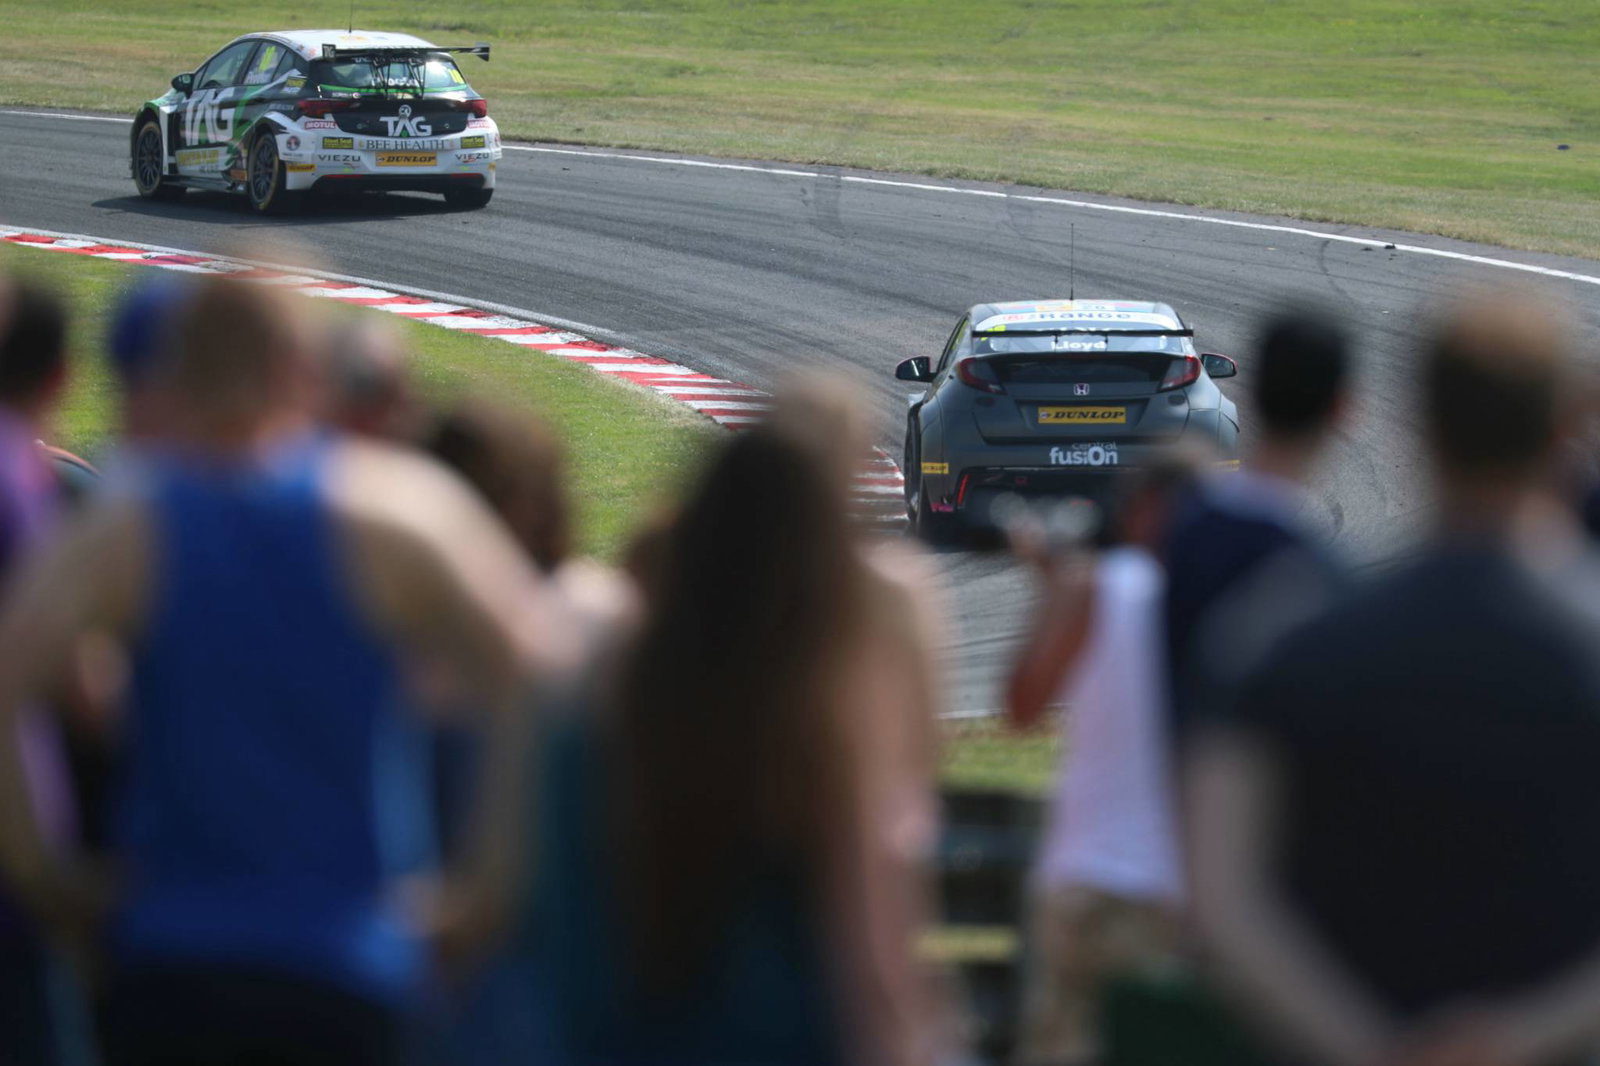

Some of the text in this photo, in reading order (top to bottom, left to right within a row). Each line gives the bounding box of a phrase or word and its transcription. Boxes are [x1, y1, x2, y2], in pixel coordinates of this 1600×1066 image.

[184, 88, 236, 147] TAG
[305, 121, 337, 130] MOTUL
[379, 116, 433, 137] TAG
[366, 140, 444, 150] BEE HEALTH
[455, 152, 489, 160] VIEZU
[1051, 341, 1106, 352] Lloyd
[1053, 411, 1124, 419] DUNLOP
